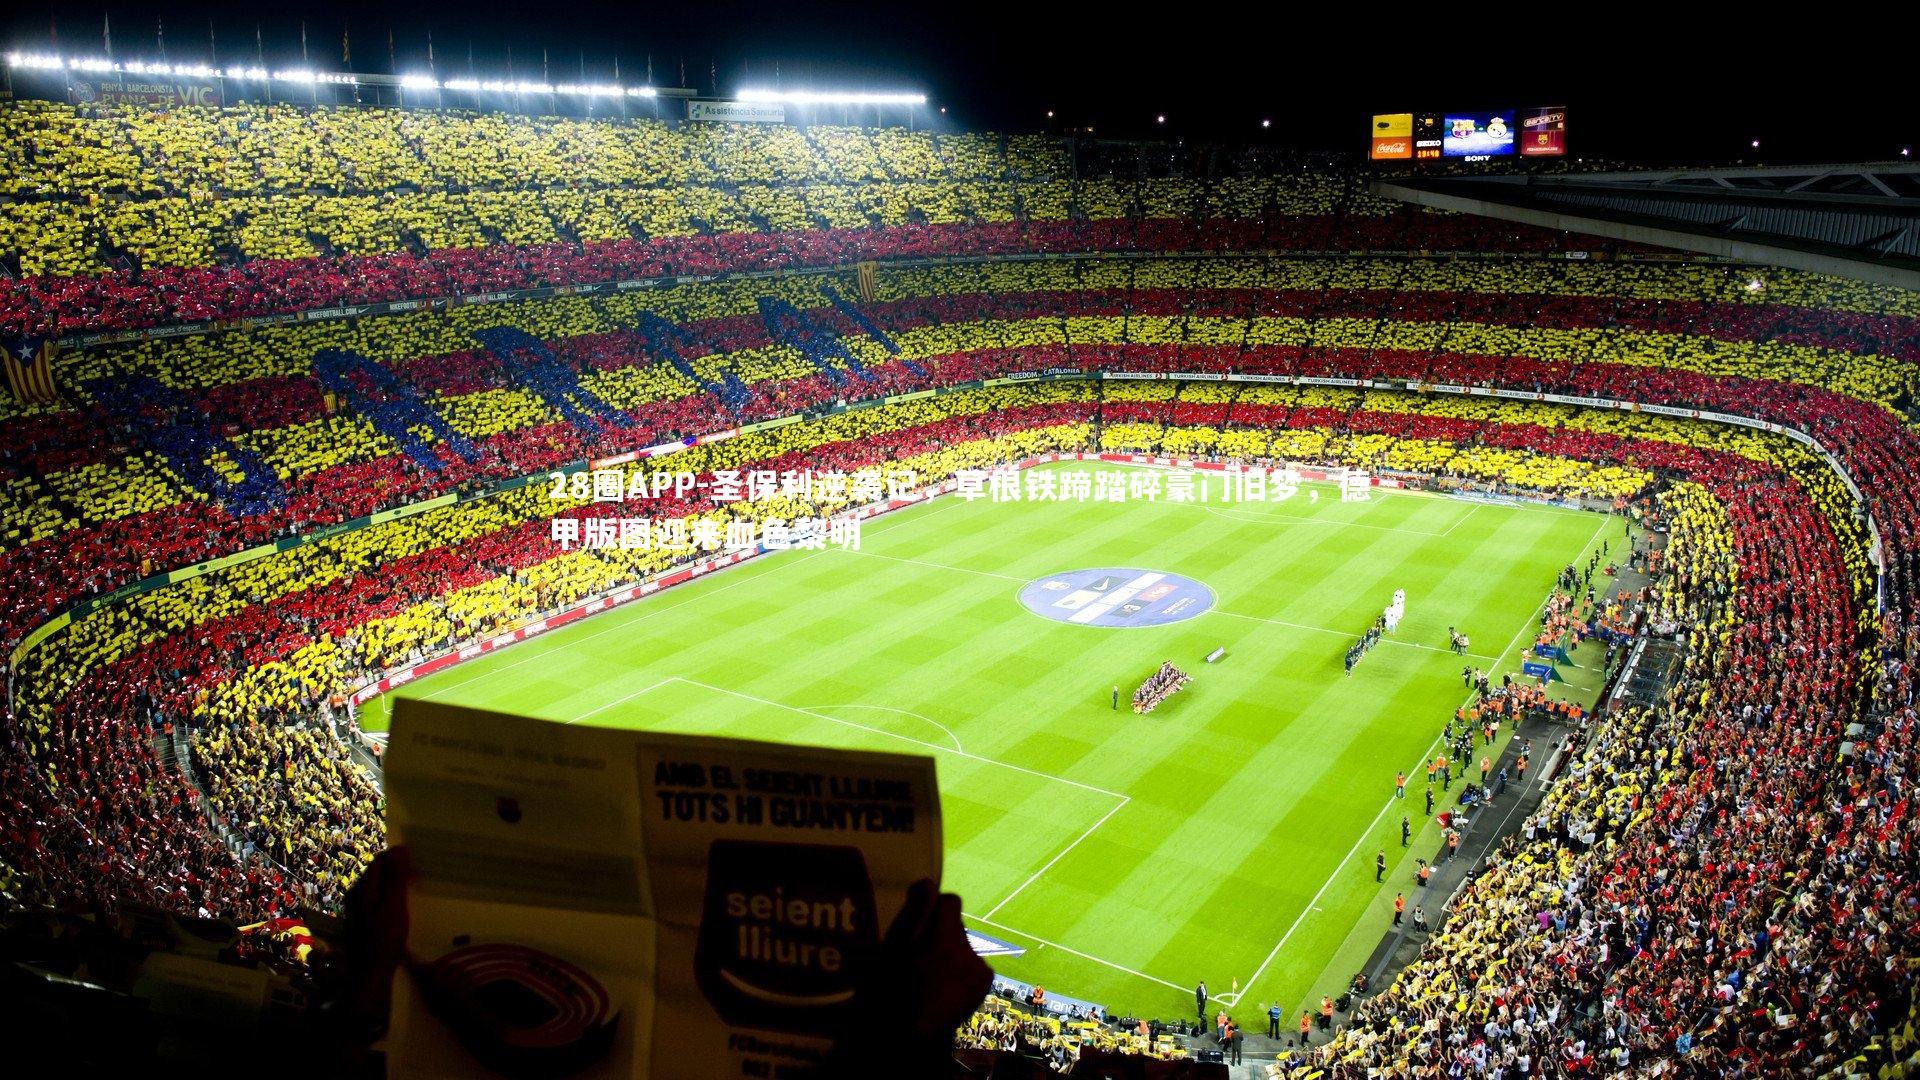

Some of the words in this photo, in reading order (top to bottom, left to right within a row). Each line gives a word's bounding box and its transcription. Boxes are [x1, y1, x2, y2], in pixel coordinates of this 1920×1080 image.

[101, 83, 124, 92] PENYA
[127, 83, 174, 94] BARCELONISTA
[102, 93, 148, 105] PLANA
[157, 95, 175, 106] DE
[177, 85, 214, 106] VIC
[307, 306, 358, 320] NIKEFOOTBALL.COM
[1007, 370, 1038, 380] FREEDOM
[1043, 367, 1080, 377] CATALONIA
[1509, 391, 1534, 399] AIRLINES
[1558, 396, 1584, 404] TURKISH
[1661, 407, 1689, 416] AIRLINES
[1714, 414, 1740, 423] TURKISH
[1739, 418, 1763, 428] AIRLINES
[654, 761, 706, 788] AMB
[710, 765, 738, 790] EL
[743, 768, 823, 798] SEIENT
[657, 790, 731, 824] TOTS
[736, 794, 763, 826] HI
[725, 883, 857, 935] seient
[737, 923, 844, 974] lliure
